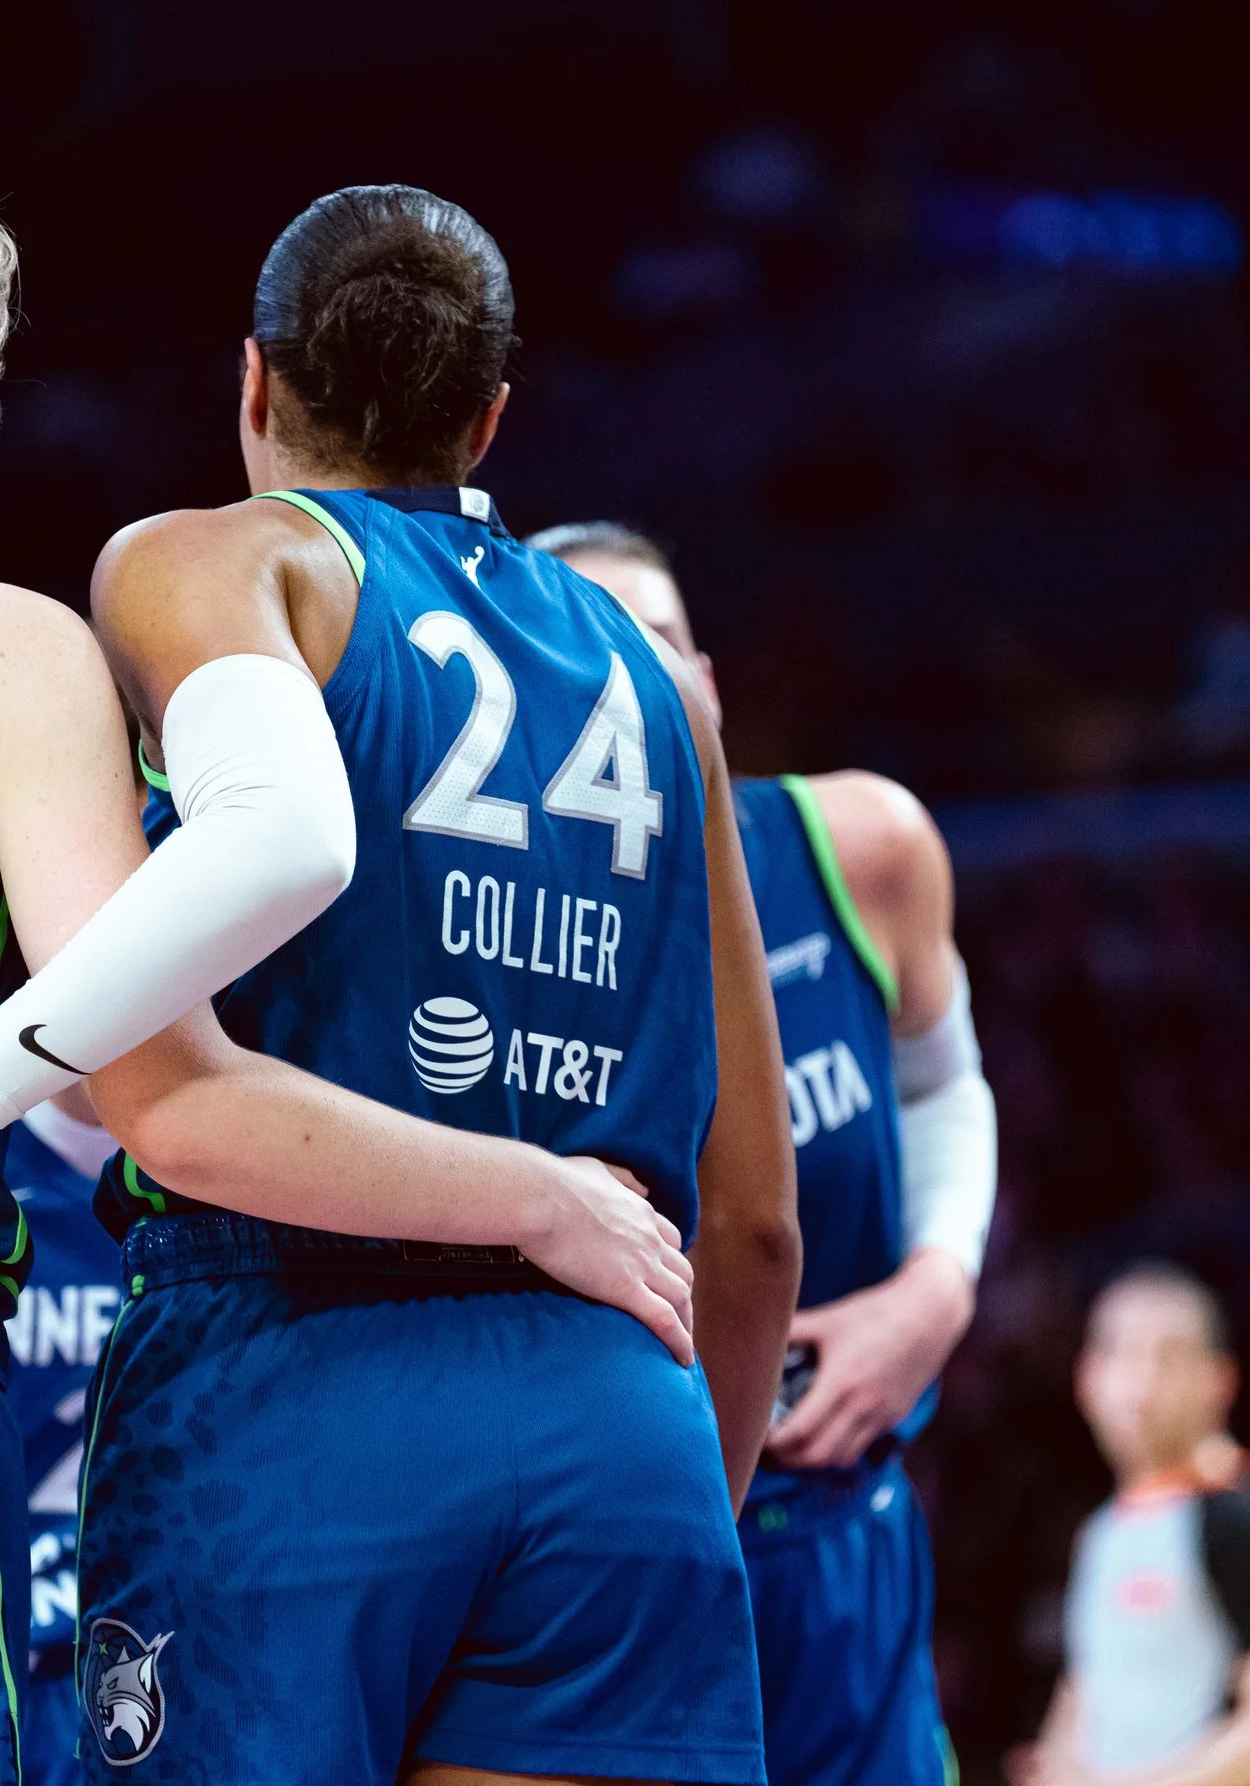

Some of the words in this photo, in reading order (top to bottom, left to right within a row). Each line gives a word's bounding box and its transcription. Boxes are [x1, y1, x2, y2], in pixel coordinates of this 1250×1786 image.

[402, 610, 663, 880] 24
[441, 870, 622, 990] COLLIER
[503, 1028, 623, 1106] AT&T
